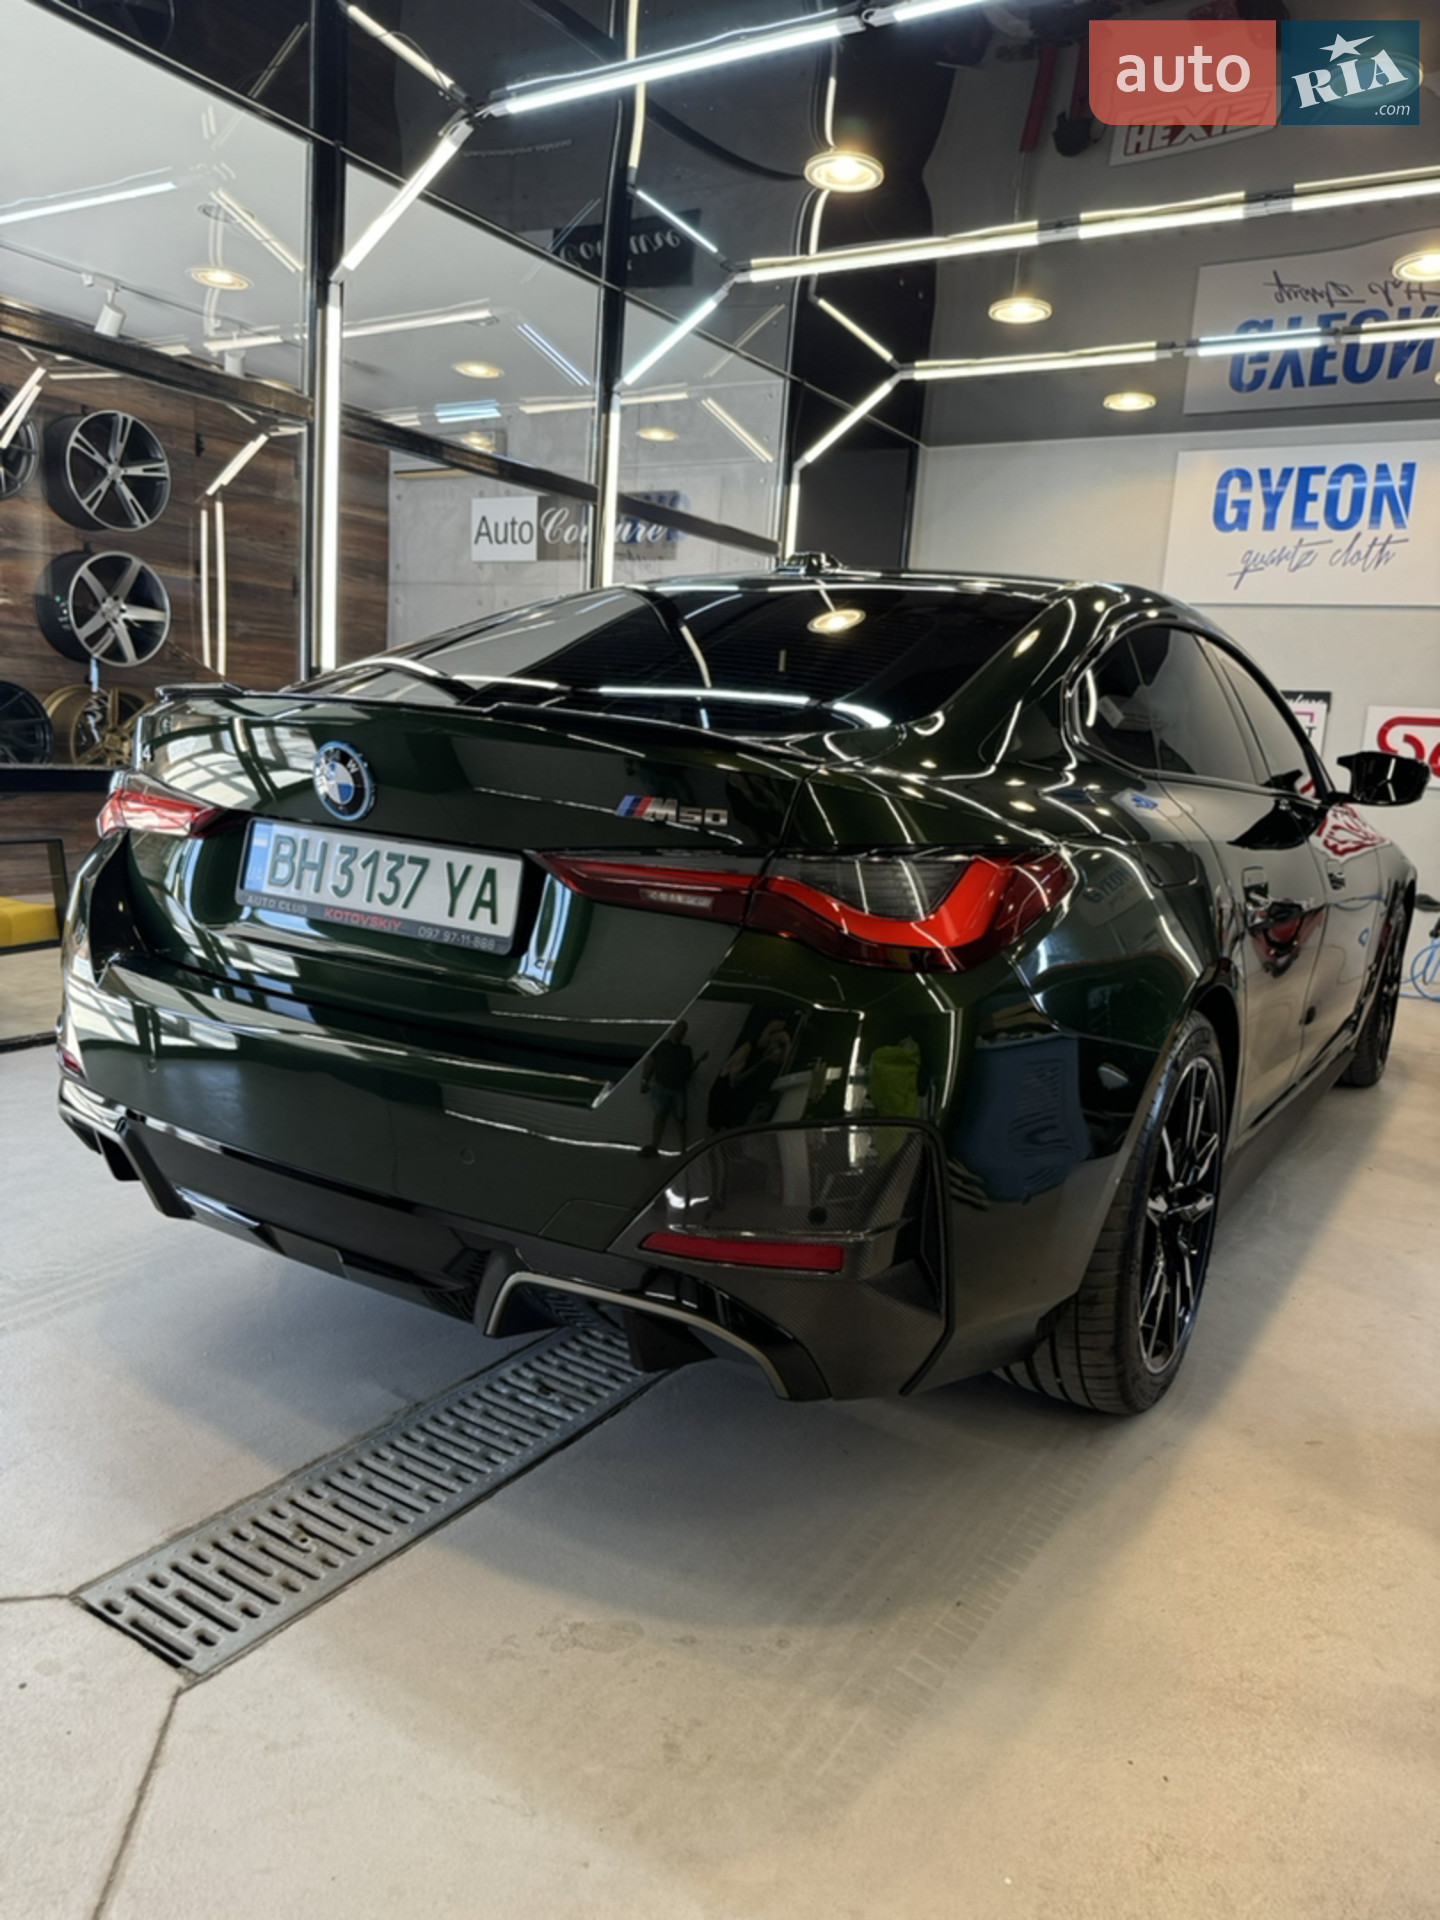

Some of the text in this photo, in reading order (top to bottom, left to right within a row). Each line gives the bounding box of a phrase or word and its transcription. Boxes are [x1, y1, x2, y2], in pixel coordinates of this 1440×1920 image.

[1212, 461, 1417, 534] GYEON
[474, 506, 669, 545] Auto Couure
[1227, 531, 1409, 591] quartz cloth
[641, 797, 729, 826] M50
[247, 895, 276, 909] AUTO
[267, 833, 499, 925] BH 3137 YA
